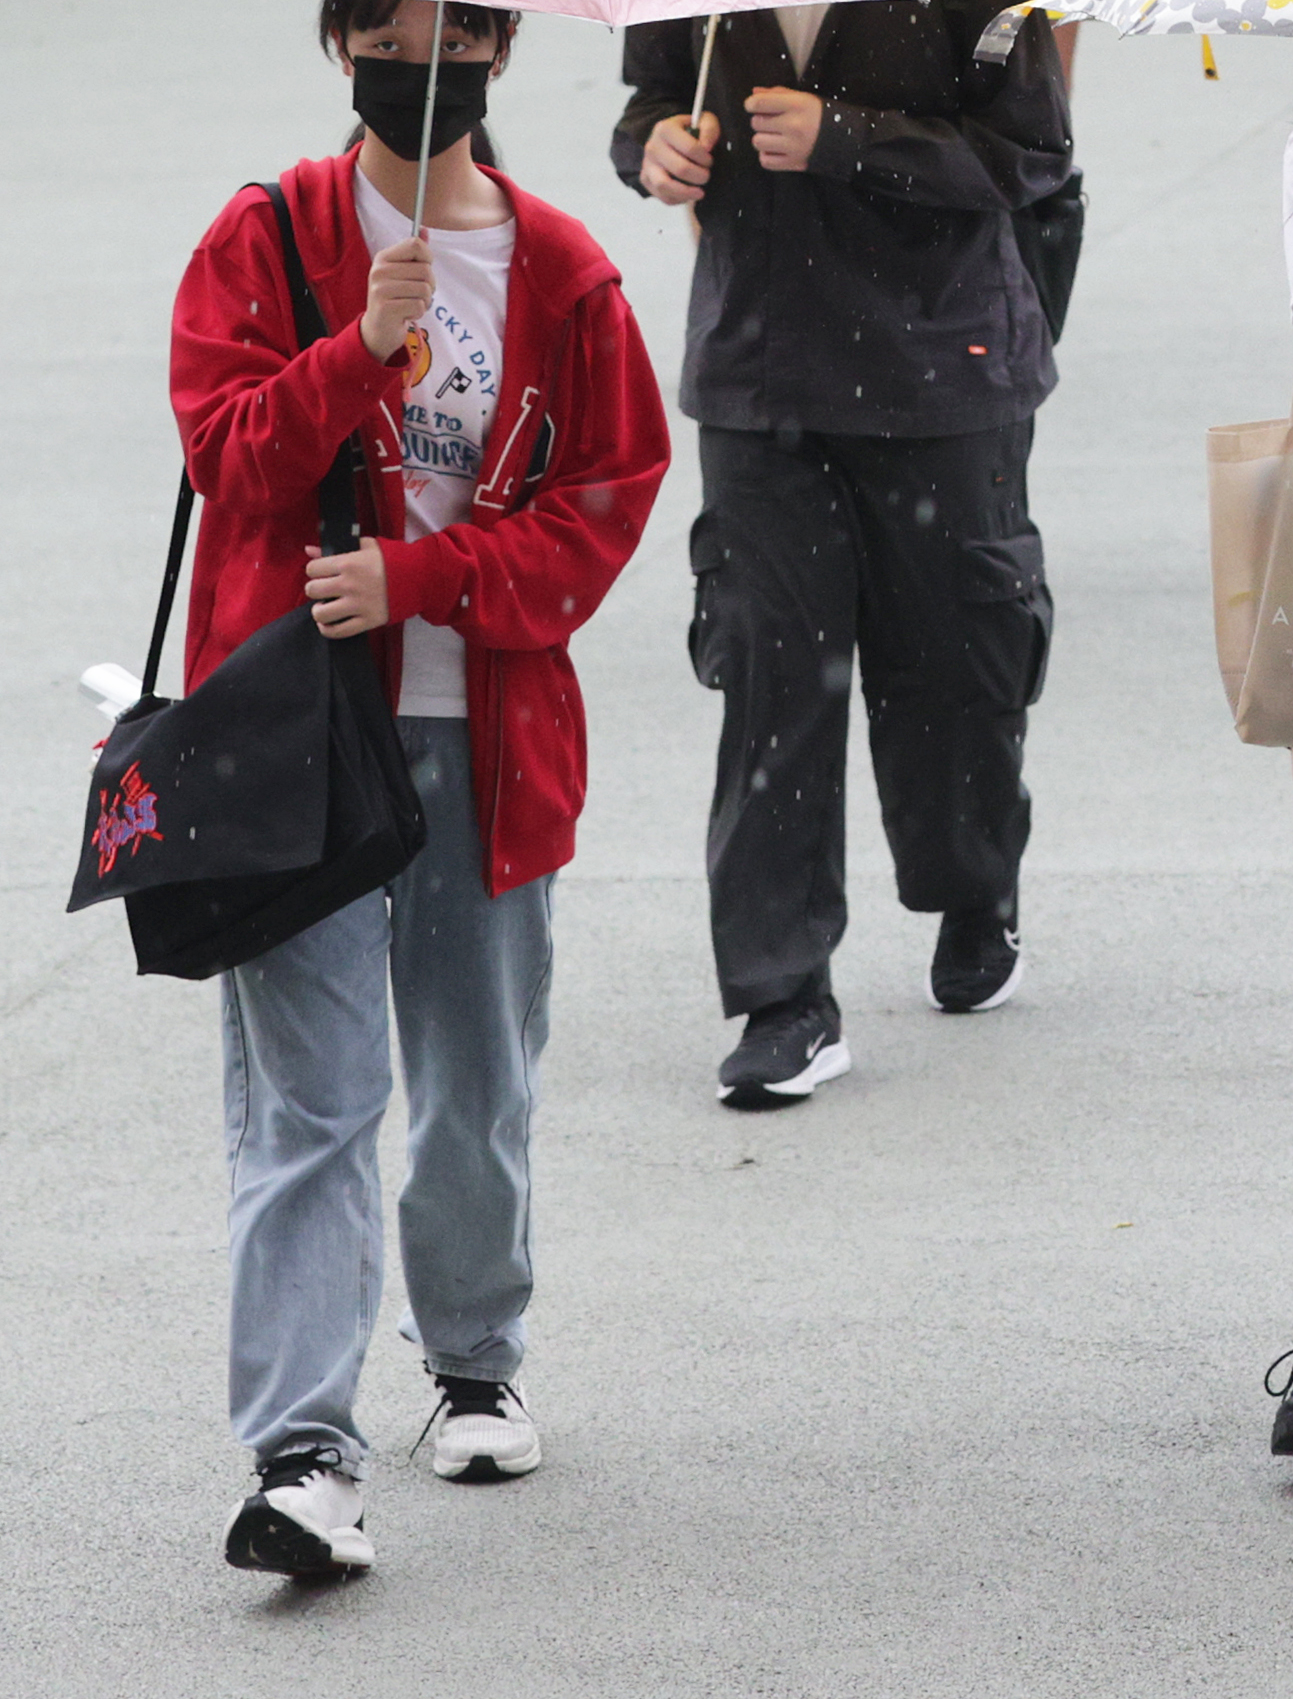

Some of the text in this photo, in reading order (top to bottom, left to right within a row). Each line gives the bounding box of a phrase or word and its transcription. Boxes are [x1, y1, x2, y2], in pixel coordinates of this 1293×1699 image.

[432, 301, 497, 398] CKY DAY
[433, 411, 463, 432] TO
